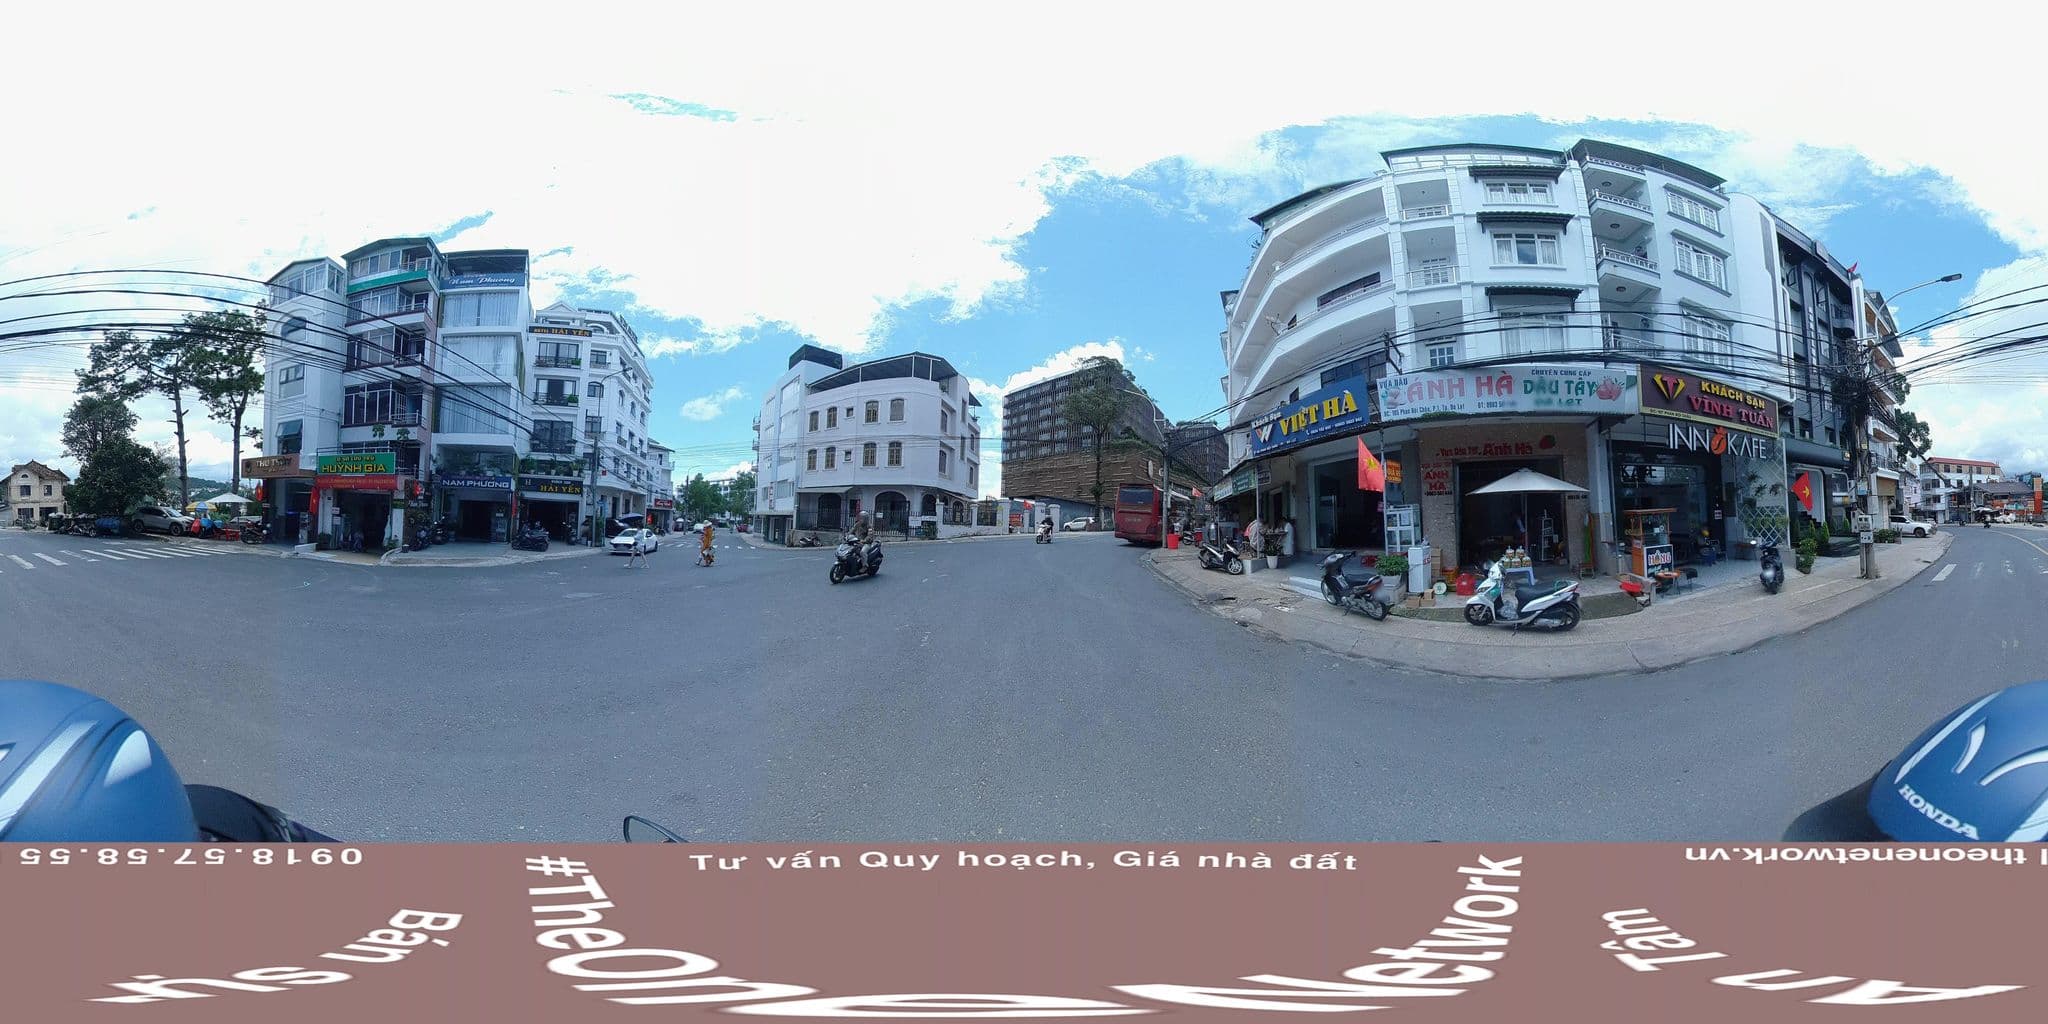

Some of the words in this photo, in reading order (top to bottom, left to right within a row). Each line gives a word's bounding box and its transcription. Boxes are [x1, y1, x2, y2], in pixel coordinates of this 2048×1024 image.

[1688, 394, 1734, 418] VĨNH
[1701, 381, 1743, 402] KHÁCH
[1746, 395, 1765, 410] SẠN
[1279, 403, 1319, 435] VIỆT
[1322, 389, 1359, 420] HÀ
[1728, 432, 1767, 459] KAFE
[322, 462, 362, 473] HUỲNH
[364, 464, 386, 473] GIA
[1898, 783, 1980, 841] HONDA
